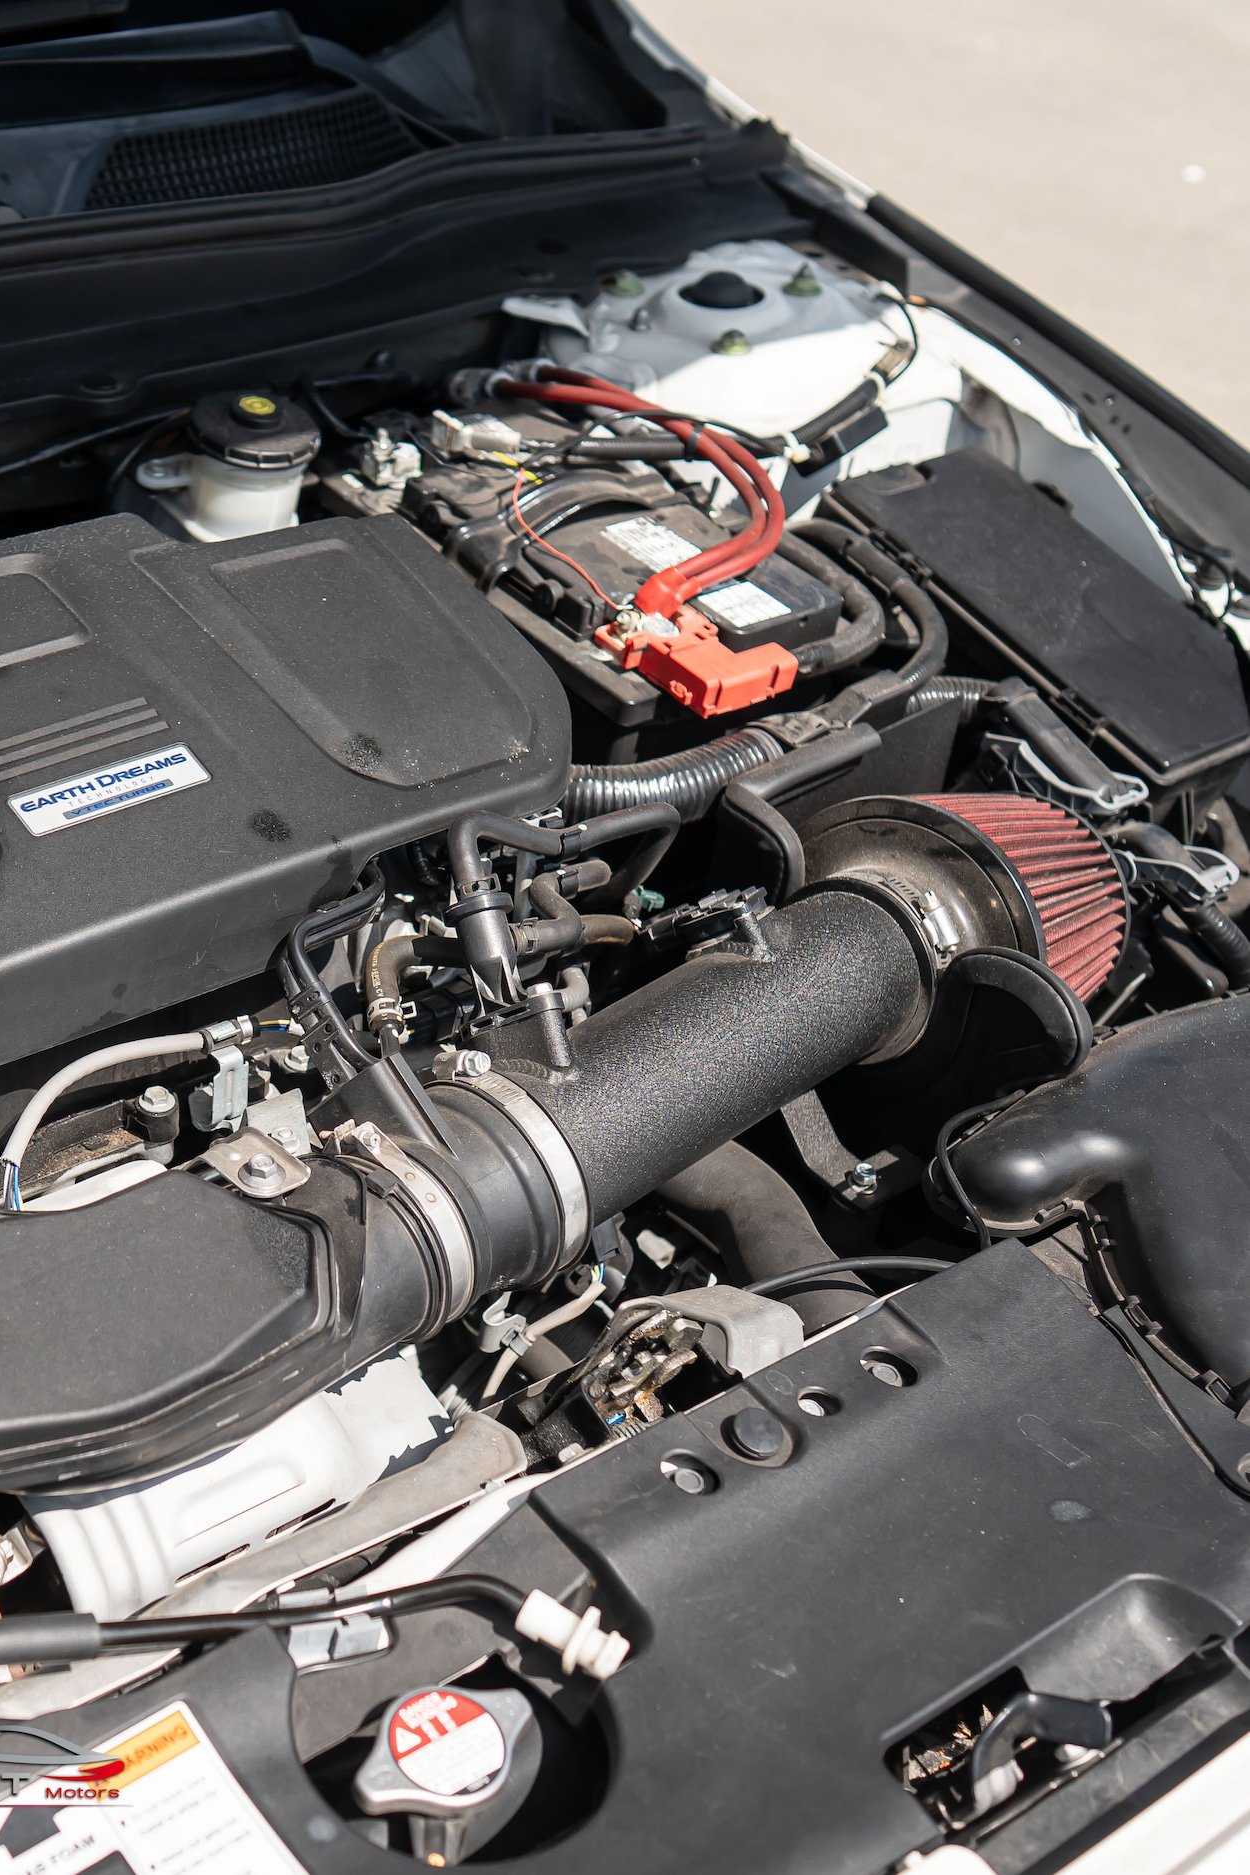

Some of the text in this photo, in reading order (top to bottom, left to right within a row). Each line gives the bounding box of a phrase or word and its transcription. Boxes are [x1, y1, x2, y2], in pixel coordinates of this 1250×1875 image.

[20, 753, 187, 812] EARTH DREAMS
[69, 775, 154, 807] TECHNOLOGY
